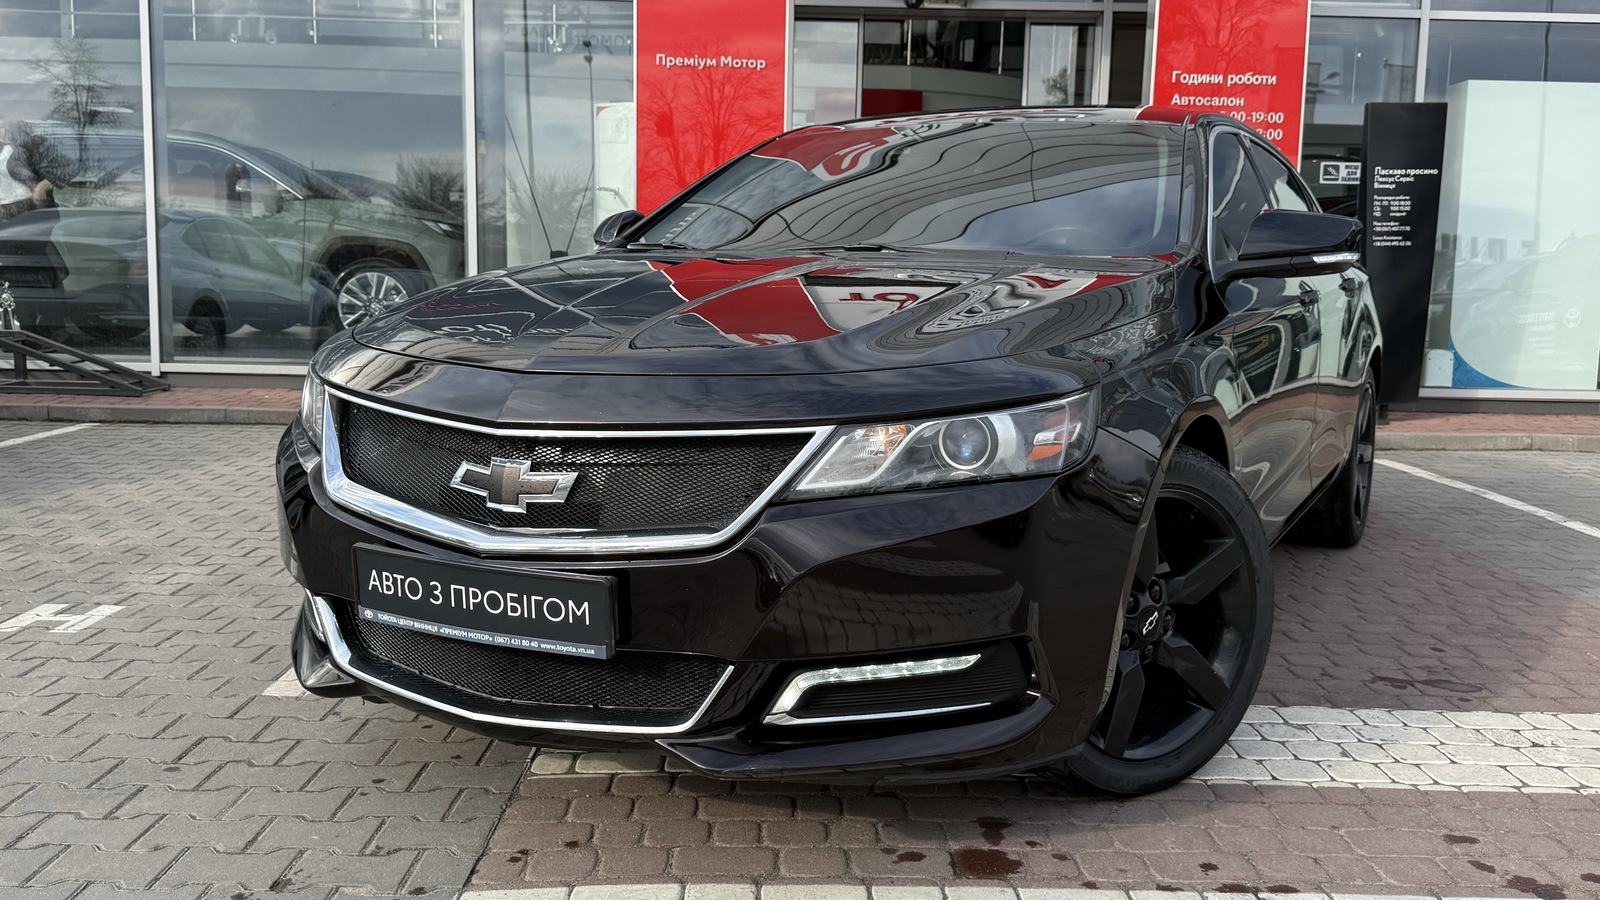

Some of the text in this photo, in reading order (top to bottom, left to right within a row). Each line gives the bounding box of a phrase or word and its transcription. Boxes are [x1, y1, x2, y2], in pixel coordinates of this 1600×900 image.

[656, 53, 766, 72] Преміум Мотор
[1171, 70, 1277, 87] Години роботи
[1170, 93, 1245, 107] Автосалон
[1220, 111, 1285, 124] :00-19:00
[1406, 168, 1439, 176] просимо
[368, 569, 591, 626] АВТО З ПРОБІГОМ
[377, 612, 398, 625] ТОЙОТА
[397, 617, 414, 627] ЦЕНТР
[414, 620, 438, 633] ВІННИЦЯ
[494, 635, 511, 645] (067)
[511, 638, 521, 646] 431
[522, 639, 530, 647] 80
[540, 642, 596, 655] www.toyota.vn.ua
